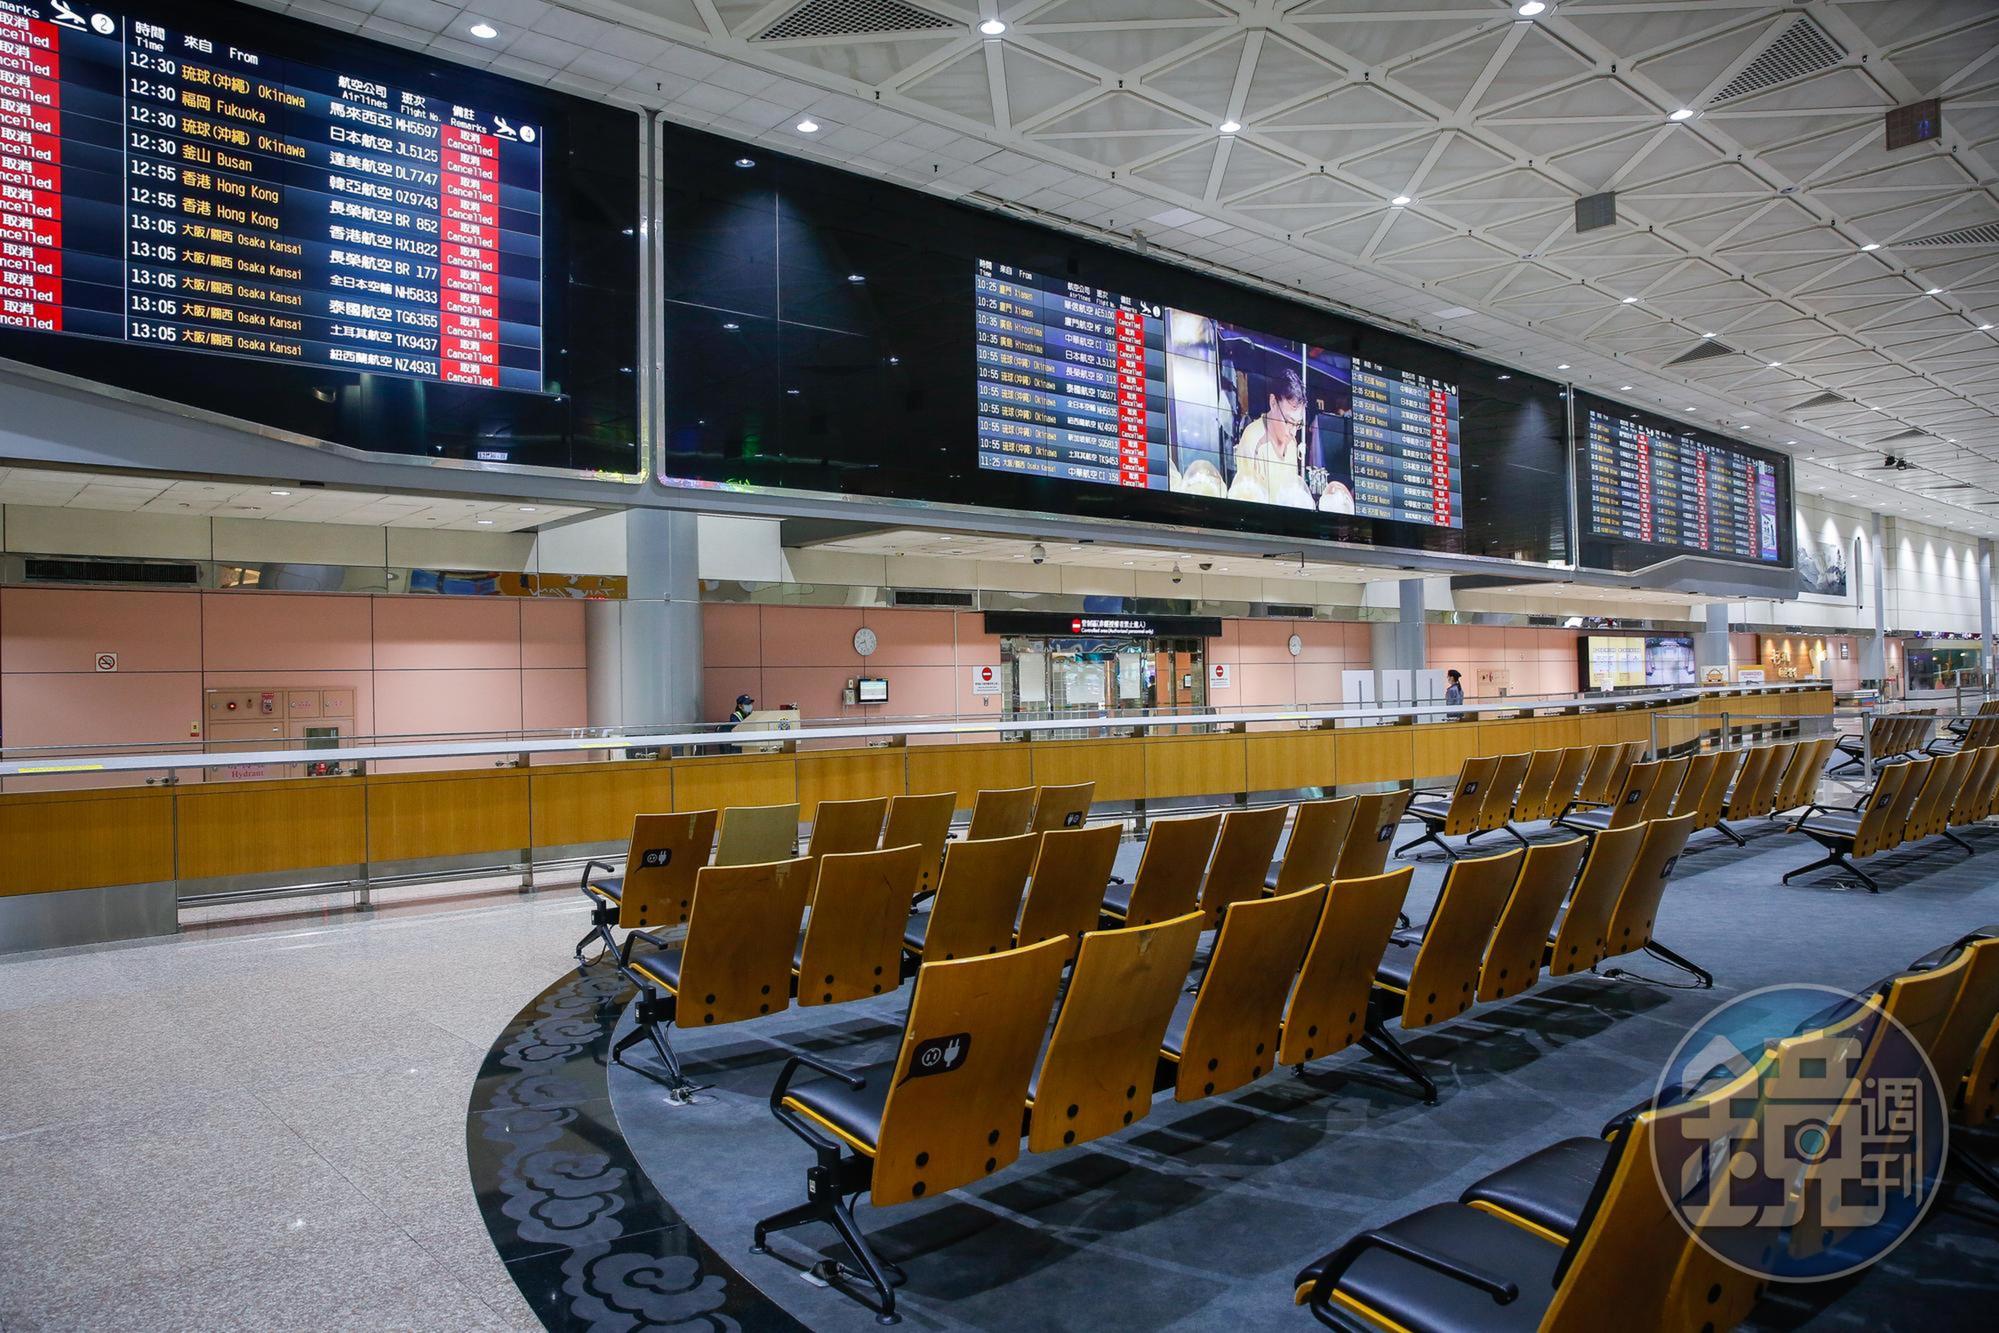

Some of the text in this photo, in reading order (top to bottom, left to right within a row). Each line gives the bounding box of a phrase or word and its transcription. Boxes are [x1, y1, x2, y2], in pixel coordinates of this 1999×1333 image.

[0, 12, 29, 30] 取消
[135, 21, 213, 54] 時間 來自
[135, 36, 164, 52] Time
[0, 40, 30, 58] 取消
[230, 48, 258, 66] From
[131, 51, 176, 75] 12:30
[0, 69, 30, 88] 取消
[131, 78, 176, 101] 12:30
[258, 82, 306, 108] Okinawa
[338, 76, 388, 98] 航空公司
[401, 91, 426, 108] 班次
[0, 98, 31, 116] 取消
[181, 91, 266, 124] 福岡 Fukuoka
[342, 90, 388, 110] Airlines
[131, 106, 176, 128] 12:30
[329, 102, 393, 128] 馬來西亞
[401, 105, 442, 122] Flight No.
[1, 126, 32, 144] 取消
[395, 117, 438, 139] MH5597
[450, 118, 488, 134] Remarks
[131, 133, 176, 155] 12:30
[258, 136, 306, 158] Okinawa
[329, 126, 393, 153] 日本航空
[447, 138, 493, 157] Cancelled
[182, 144, 252, 172] 釜山 Busan
[395, 142, 438, 163] JL5125
[2, 156, 32, 173] 取消
[131, 160, 176, 181] 12:55
[329, 151, 393, 177] 達美航空
[447, 162, 493, 180] Cancelled
[395, 167, 438, 186] DL7747
[2, 185, 32, 201] 取消
[182, 170, 279, 204] 香港 Hong Kong
[329, 175, 393, 200] 韓亞航空
[447, 185, 493, 203] Cancelled
[131, 187, 176, 208] 12:55
[395, 190, 438, 210] OZ9743
[2, 213, 33, 230] 取消
[182, 198, 279, 230] 香港 Hong Kong
[329, 200, 393, 225] 長榮航空
[447, 208, 493, 226] Cancelled
[131, 214, 176, 234] 13:05
[395, 214, 438, 233] BR 852
[237, 234, 266, 248] Osaka
[329, 225, 393, 250] 香港航空
[447, 232, 493, 249] Cancelled
[3, 243, 33, 259] 取消
[131, 241, 176, 261] 13:05
[395, 238, 438, 257] HX1822
[237, 260, 266, 274] Osaka
[329, 250, 393, 274] 長榮航空
[447, 255, 493, 272] Cancelled
[4, 271, 34, 287] 取消
[131, 268, 176, 288] 13:05
[395, 263, 438, 280] BR 177
[237, 286, 266, 300] Osaka
[329, 274, 393, 295] 全日本空輸
[447, 278, 493, 294] Cancelled
[977, 279, 997, 291] 10:25
[395, 285, 438, 304] NH5833
[978, 296, 997, 309] 10:25
[4, 300, 34, 315] 取消
[131, 295, 176, 314] 13:05
[329, 300, 393, 322] 泰國航空
[447, 302, 493, 317] Cancelled
[237, 312, 266, 326] Osaka
[395, 310, 438, 328] TG6355
[978, 314, 997, 327] 10:35
[131, 323, 176, 341] 13:05
[329, 325, 393, 342] 土耳其航空
[447, 325, 493, 340] Cancelled
[979, 332, 998, 344] 10:35
[237, 338, 266, 351] Osaka
[395, 333, 438, 351] TK9437
[329, 349, 393, 367] 紐西蘭航空
[447, 348, 493, 363] Cancelled
[979, 349, 998, 361] 10:55
[395, 358, 438, 376] NZ4931
[980, 367, 998, 379] 10:55
[447, 372, 493, 386] Cancelled
[980, 385, 999, 396] 10:55
[980, 402, 999, 414] 10:55
[980, 420, 1000, 432] 10:55
[980, 438, 1000, 450] 10:55
[980, 456, 1000, 467] 11:25
[232, 770, 264, 778] Hydrant
